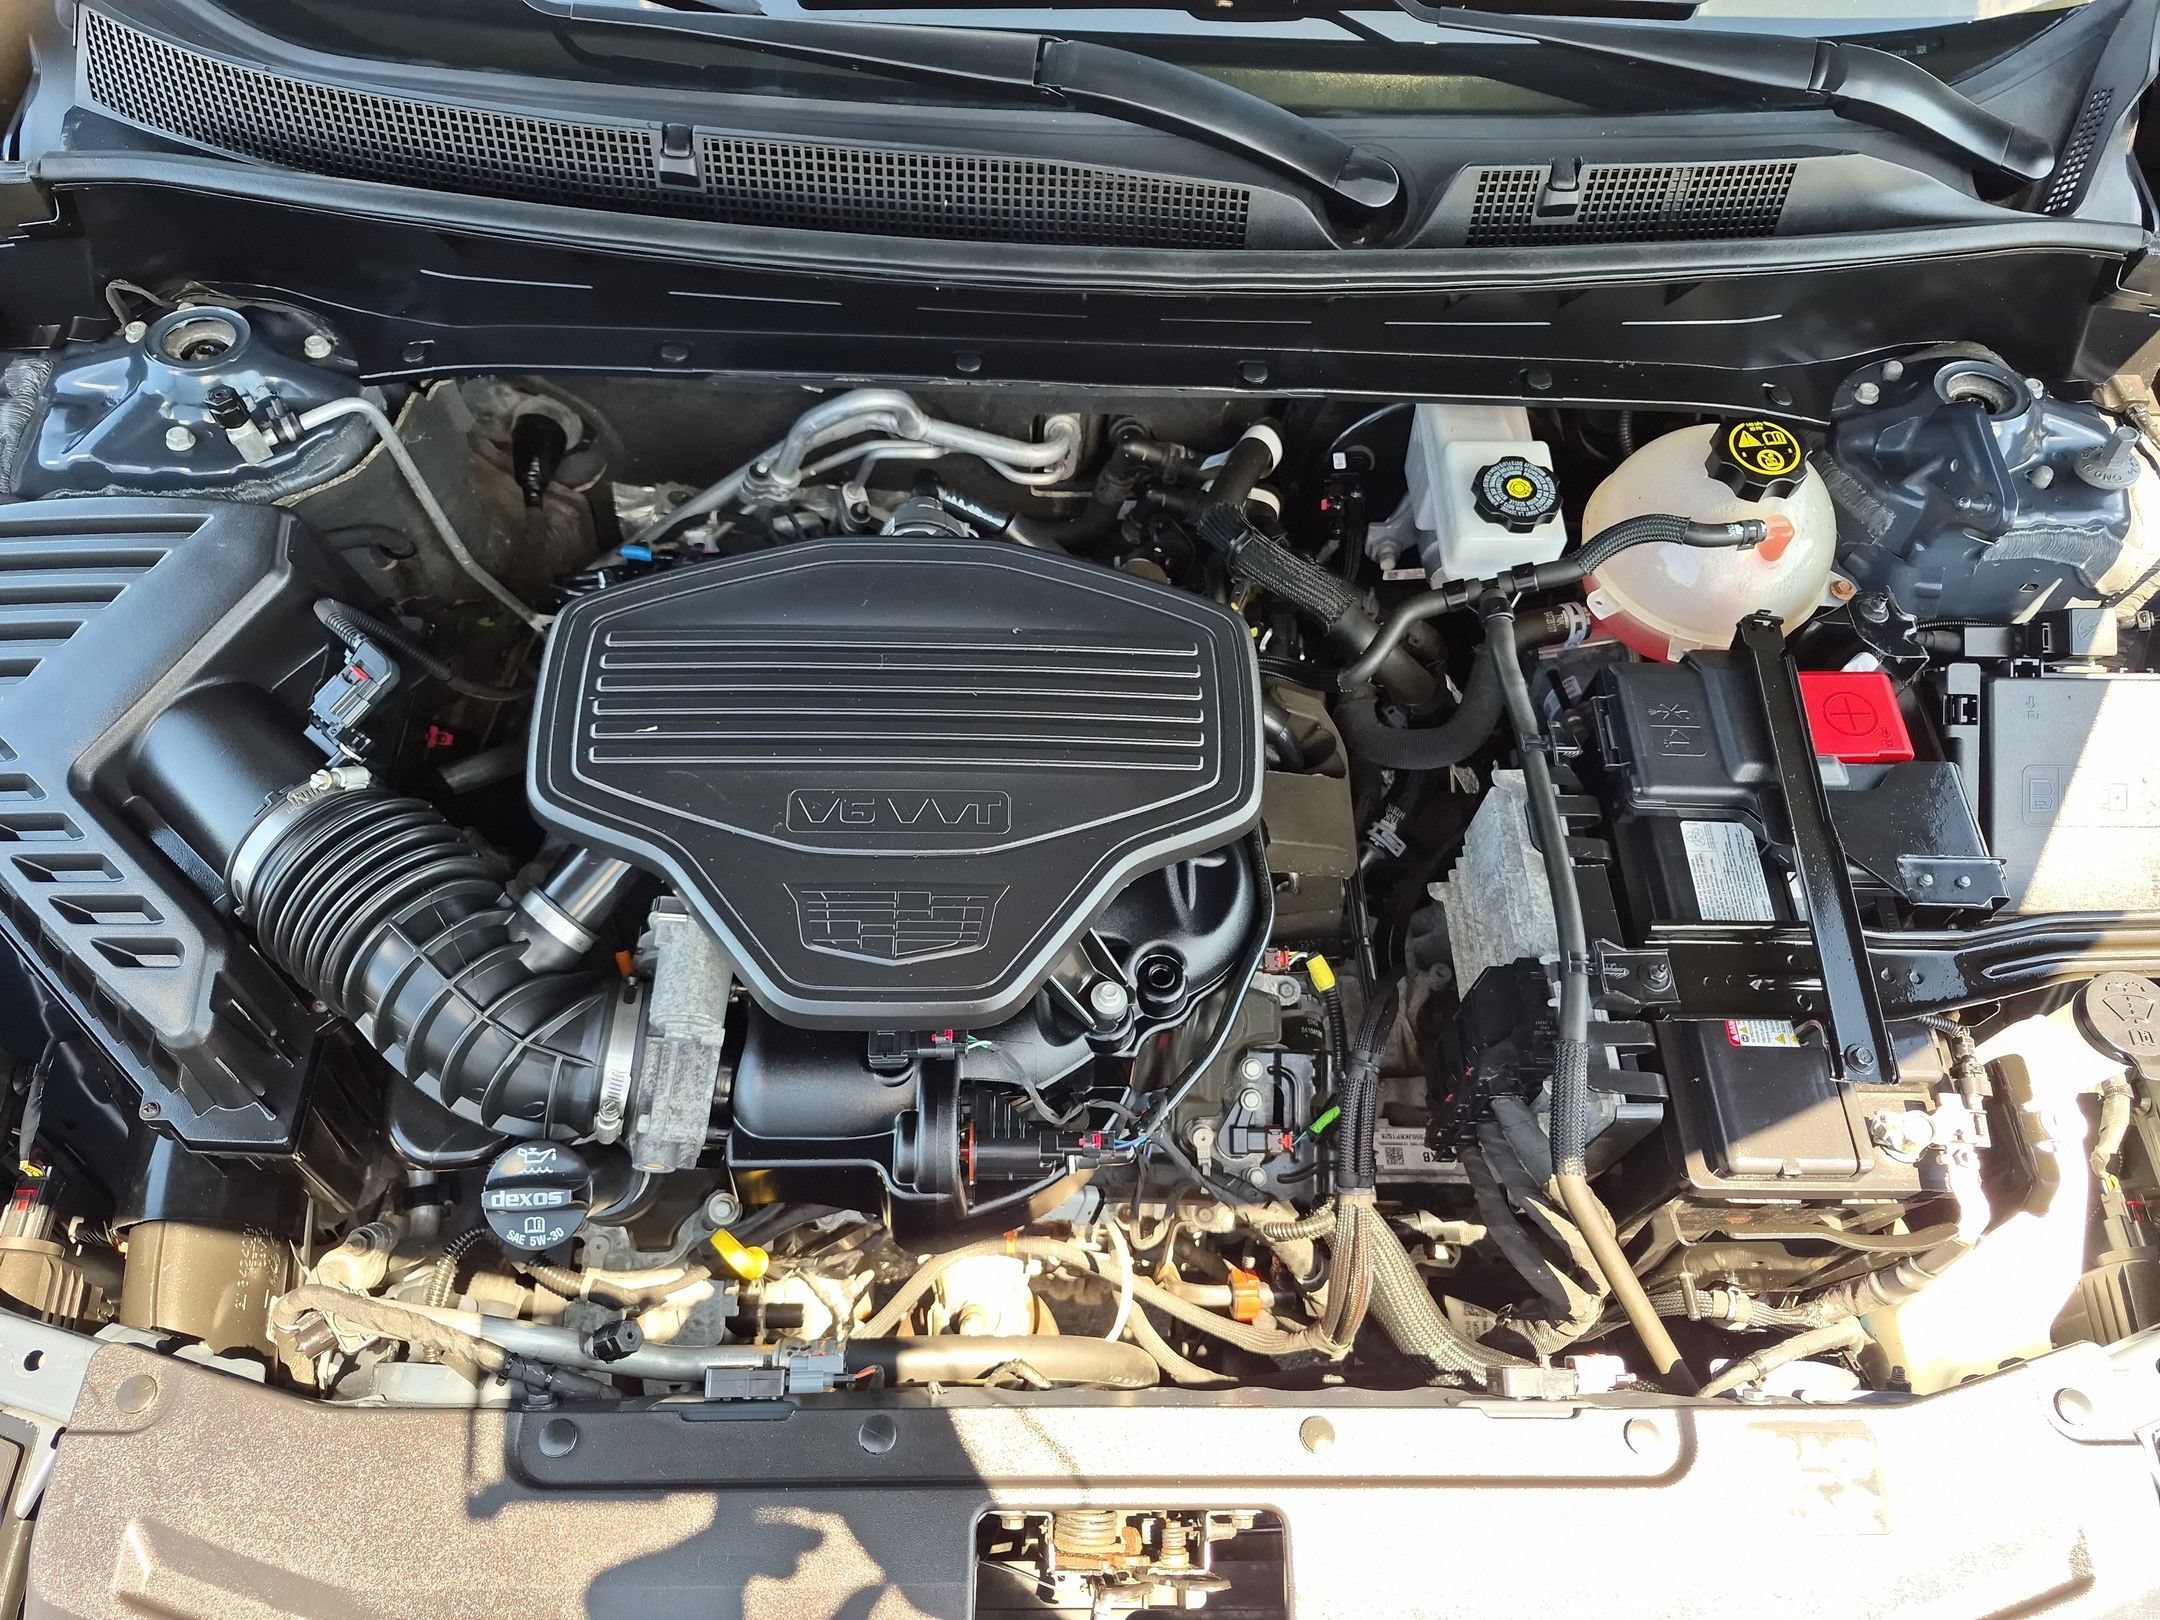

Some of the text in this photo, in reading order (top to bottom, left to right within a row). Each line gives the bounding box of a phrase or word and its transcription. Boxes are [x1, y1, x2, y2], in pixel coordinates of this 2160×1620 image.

[798, 797, 1002, 825] V6 VVT
[491, 1190, 563, 1207] dexos
[506, 1227, 565, 1247] SAE 5W-30
